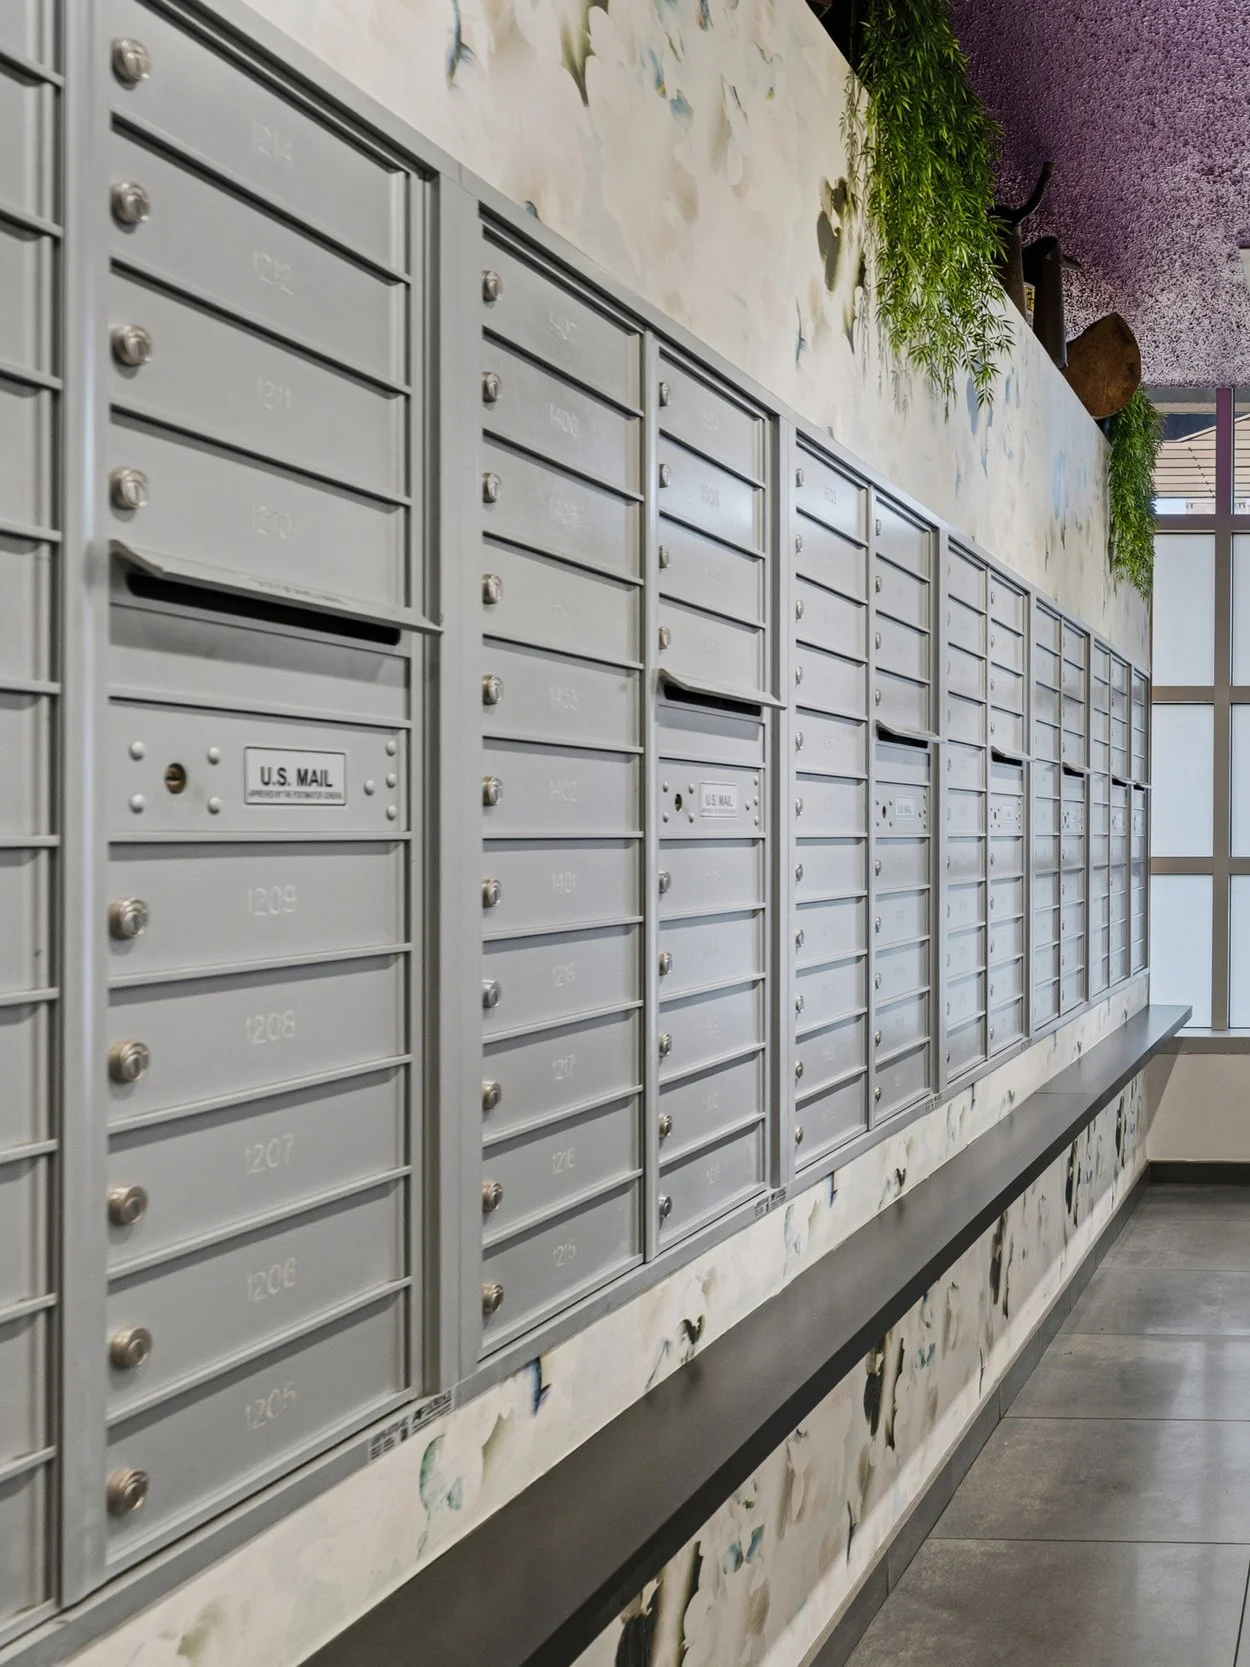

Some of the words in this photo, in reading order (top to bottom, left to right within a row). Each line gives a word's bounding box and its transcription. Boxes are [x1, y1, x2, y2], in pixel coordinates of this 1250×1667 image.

[260, 766, 291, 786] U.S.
[296, 768, 333, 787] MAIL
[718, 795, 734, 807] MAIL
[248, 885, 297, 916] 1209
[245, 1009, 296, 1045] 1208
[244, 1133, 295, 1175] 1207
[246, 1257, 298, 1302] 1206
